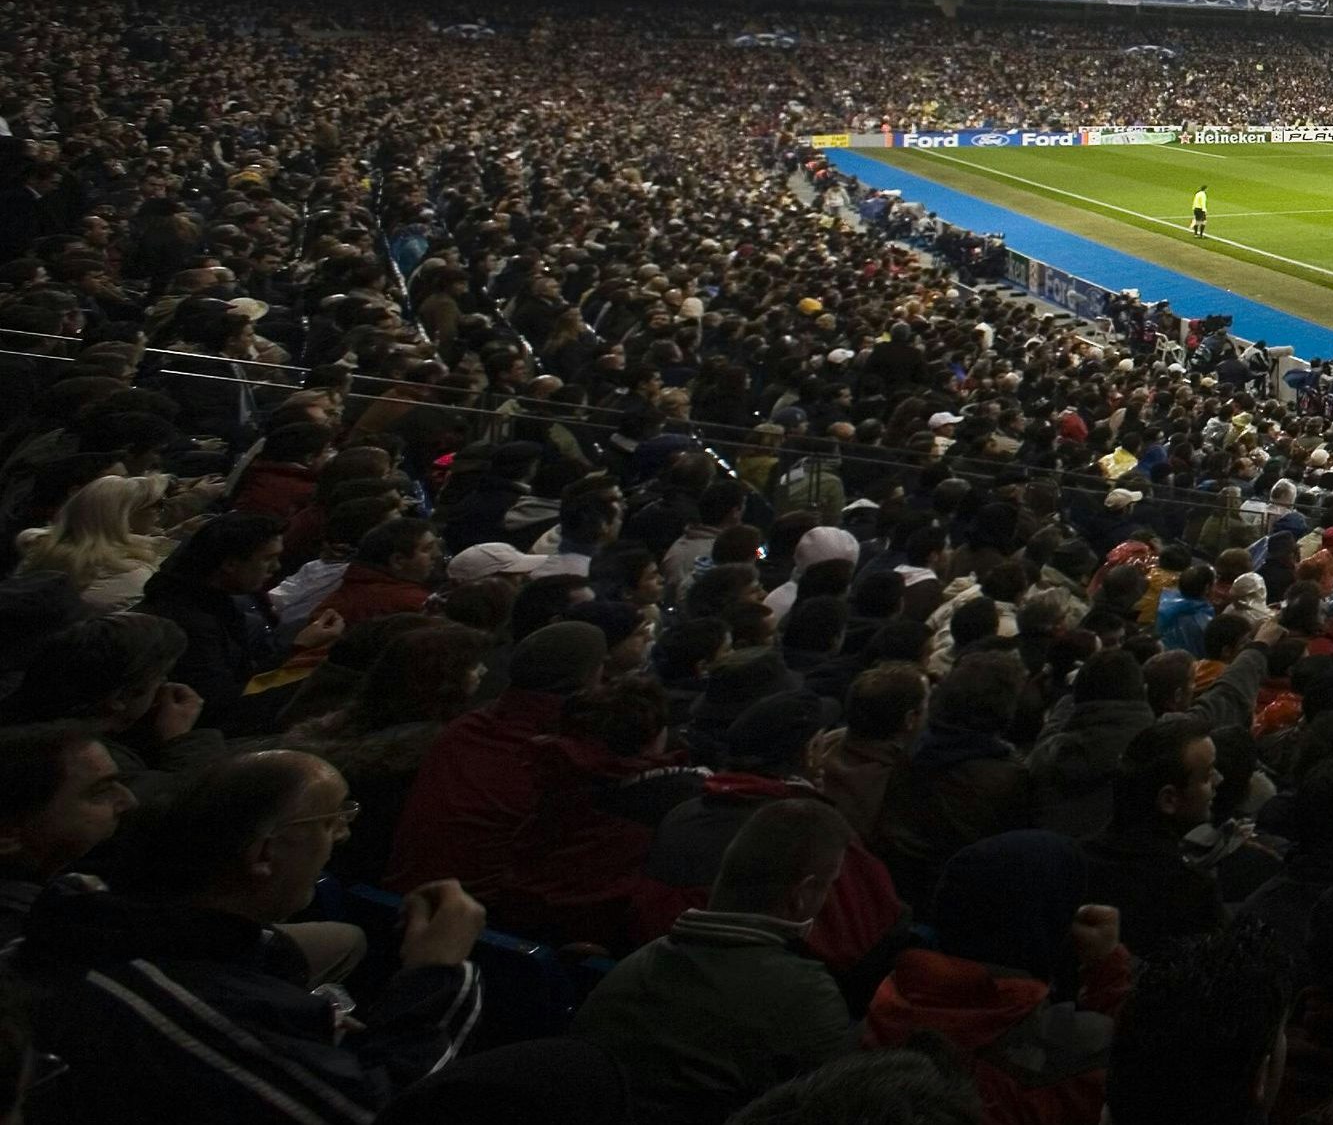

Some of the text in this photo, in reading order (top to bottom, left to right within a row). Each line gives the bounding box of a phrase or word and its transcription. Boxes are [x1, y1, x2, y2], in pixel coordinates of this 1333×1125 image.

[903, 133, 960, 148] Ford
[1021, 132, 1074, 147] Ford
[1194, 131, 1267, 144] Heineken
